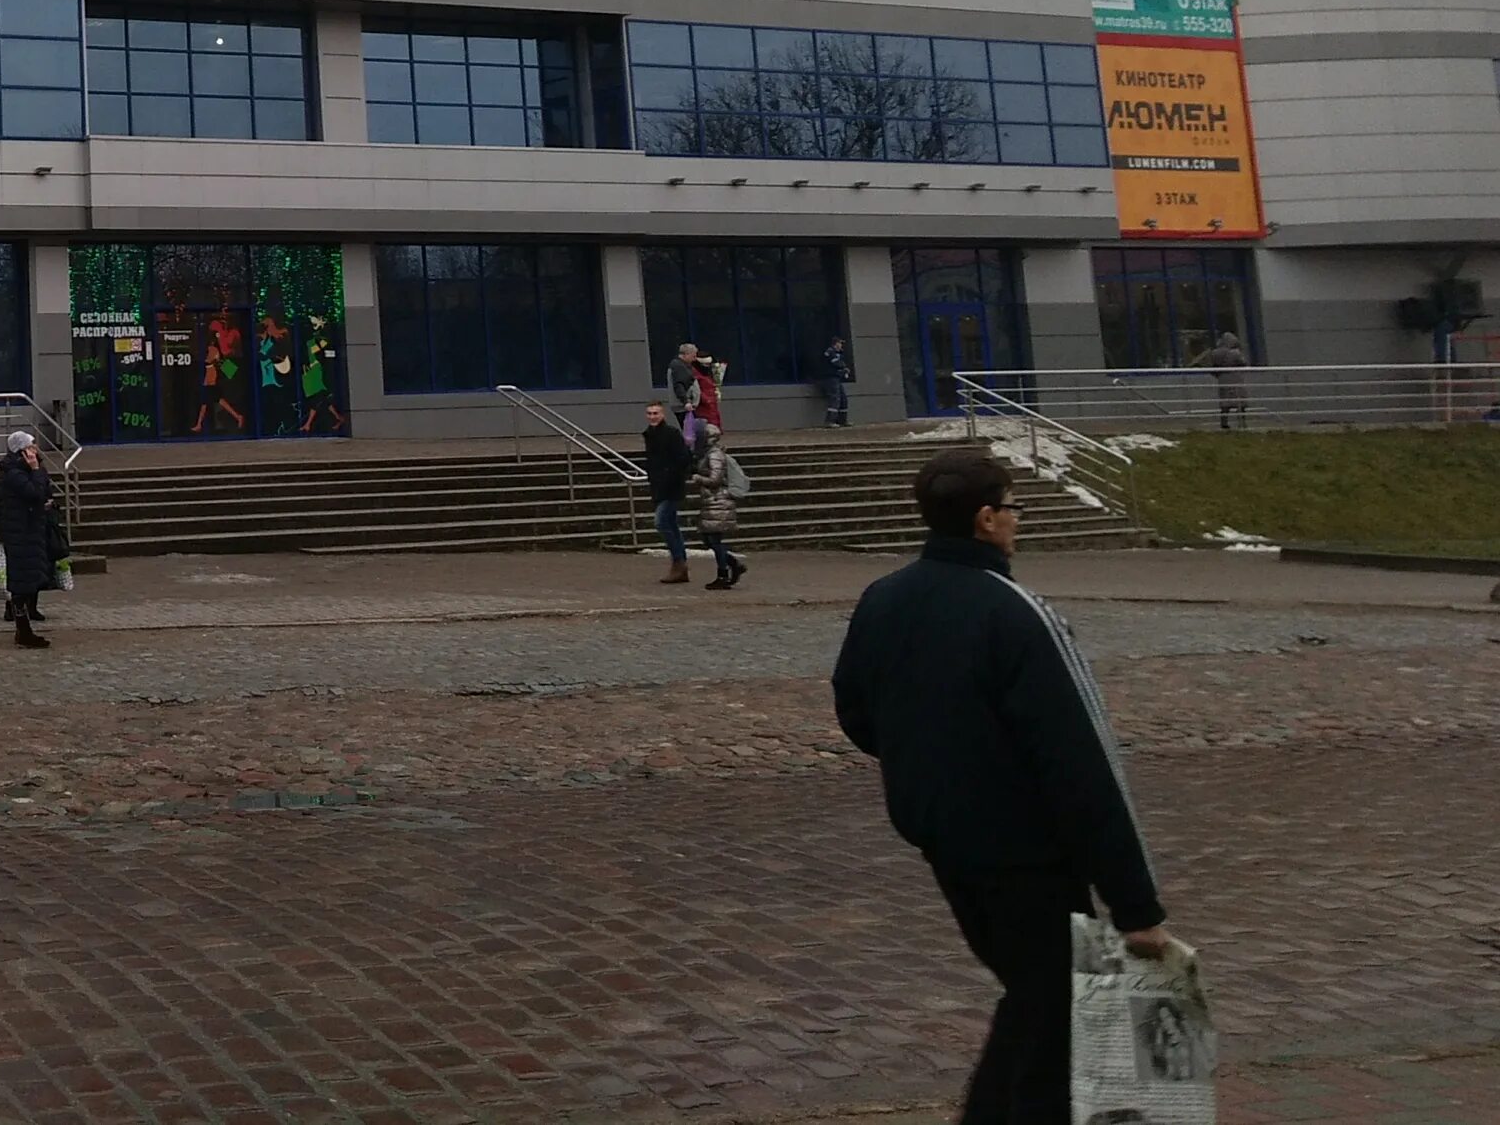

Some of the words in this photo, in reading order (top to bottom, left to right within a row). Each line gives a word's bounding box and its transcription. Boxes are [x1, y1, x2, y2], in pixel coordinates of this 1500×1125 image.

[1115, 70, 1205, 89] КИНОТЕАТР
[1128, 157, 1215, 169] LUMENFILM.COM
[1155, 193, 1161, 205] 3
[1167, 192, 1198, 205] ЭТАЖ
[72, 326, 145, 337] РАСПРОДАЖА
[161, 354, 191, 366] 10-20
